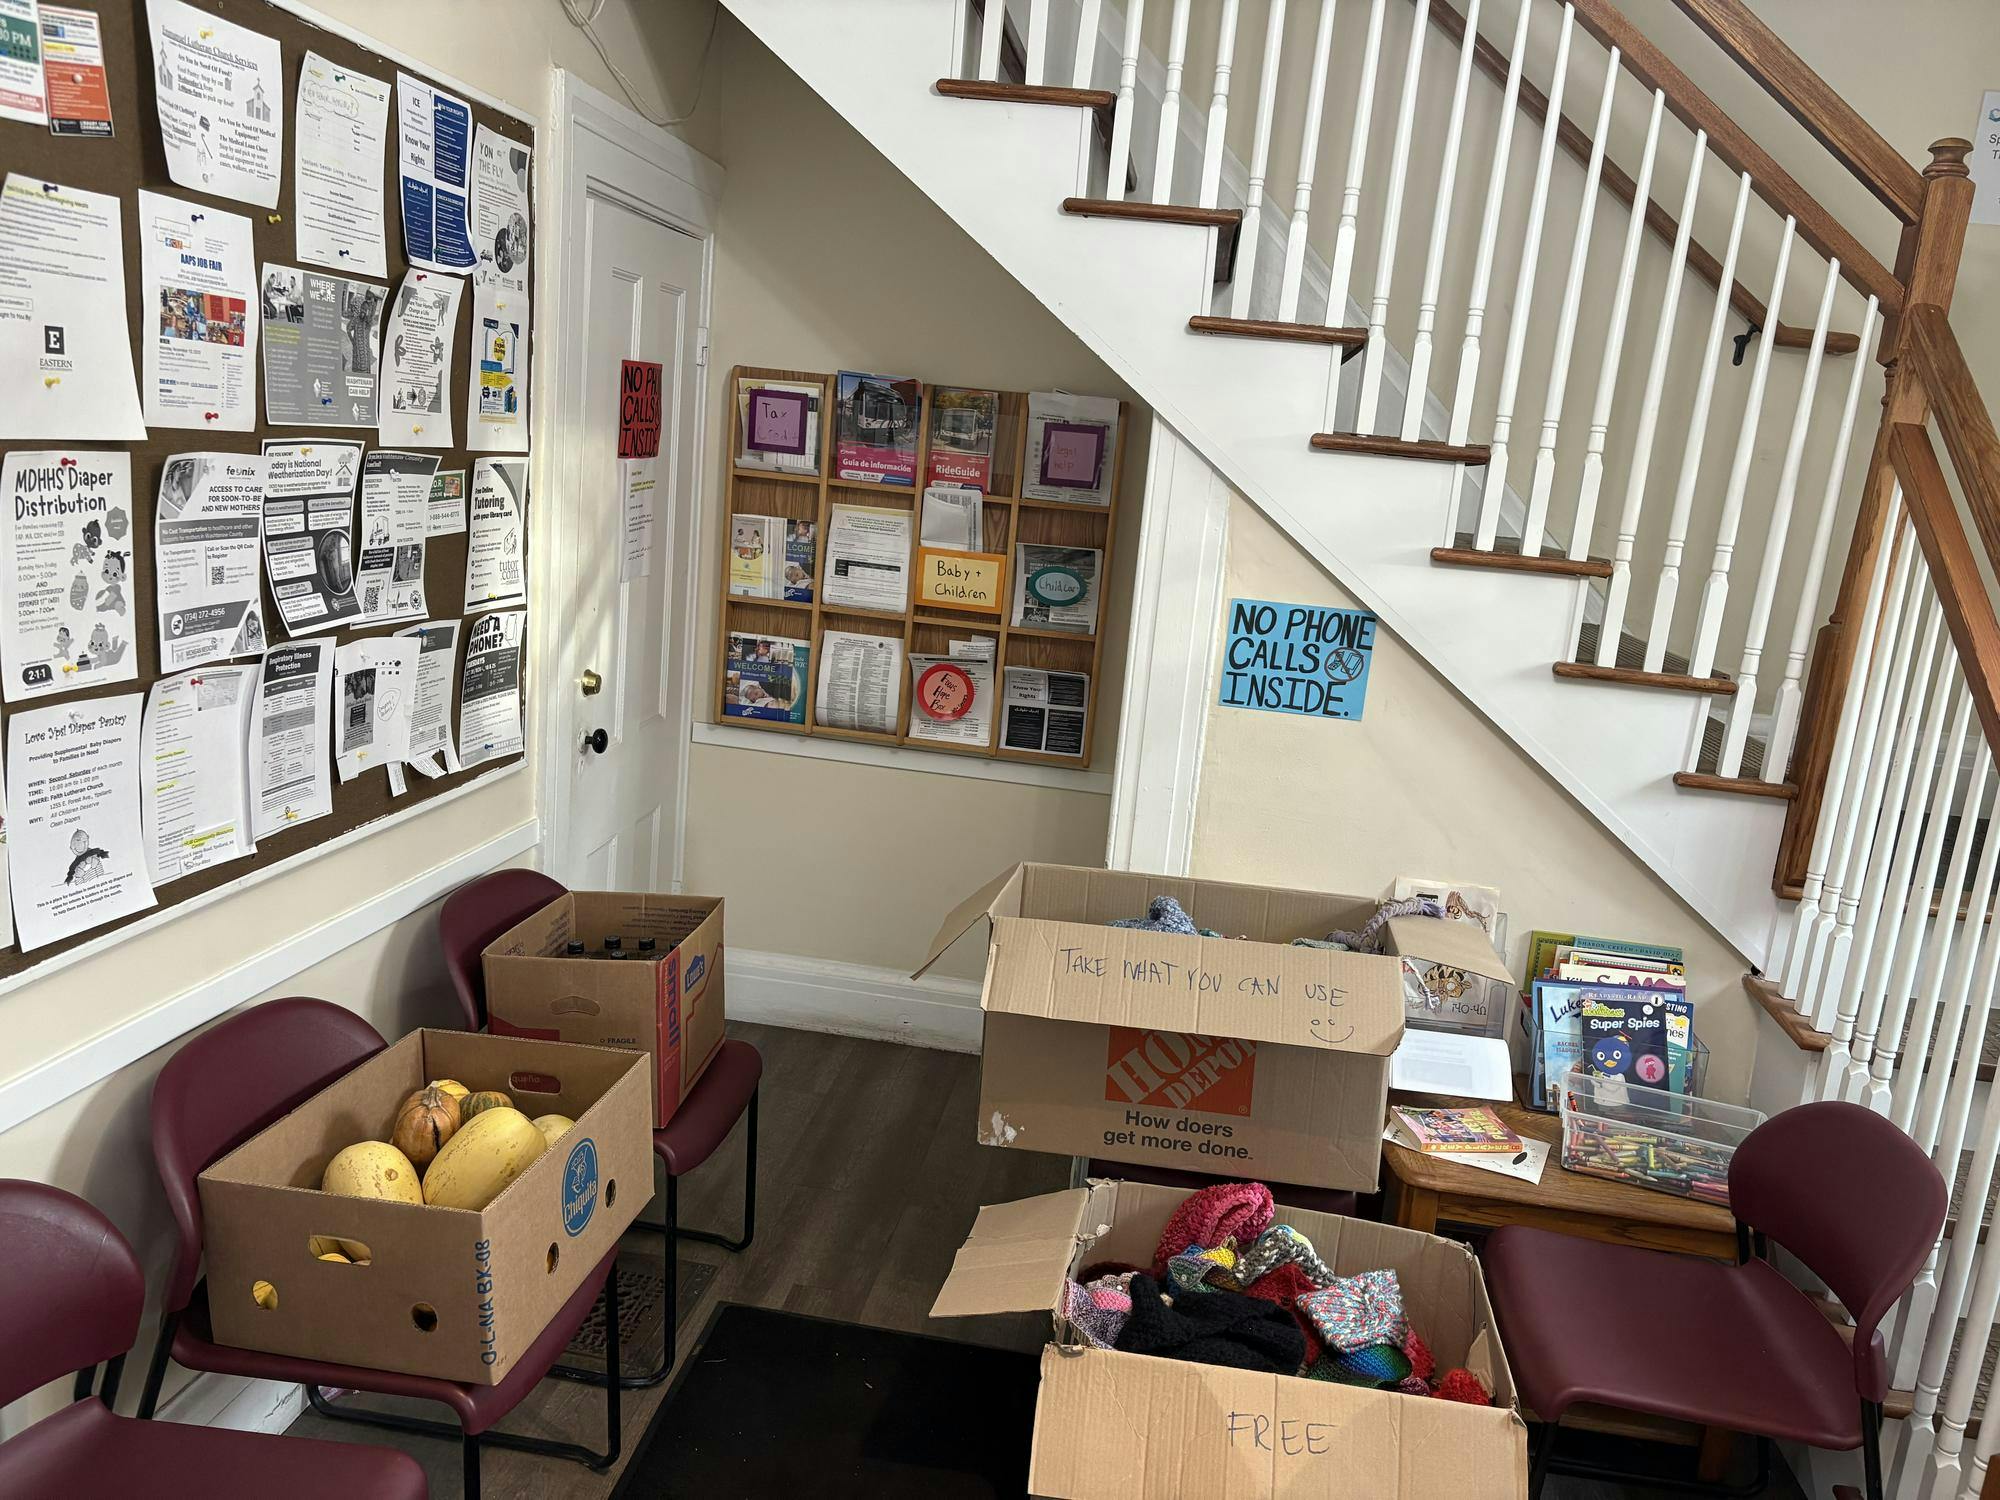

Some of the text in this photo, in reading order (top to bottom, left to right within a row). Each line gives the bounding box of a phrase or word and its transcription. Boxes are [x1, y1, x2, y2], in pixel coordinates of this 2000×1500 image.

[199, 60, 211, 71] Need
[213, 46, 258, 70] Church Services
[412, 97, 421, 109] ICE
[242, 123, 276, 138] Need Medical
[228, 136, 245, 148] Medical
[404, 133, 431, 152] Know Your
[410, 153, 426, 166] Rights
[478, 158, 504, 179] THE FLY
[180, 253, 223, 272] AAPS JOB FAIR
[309, 279, 336, 291] WHERE
[309, 290, 320, 301] WE
[39, 357, 73, 369] EASTERN
[623, 365, 643, 394] NO
[622, 395, 655, 426] CALLS
[762, 402, 788, 419] Tax
[287, 459, 322, 469] is National
[860, 460, 869, 468] de
[870, 460, 912, 474] información
[935, 464, 981, 478] RideGuide
[15, 466, 113, 493] MDHHS Diaper
[268, 468, 333, 480] Weatherization Day!
[209, 485, 263, 493] ACCESS TO CARE
[15, 493, 107, 521] Distribution
[208, 495, 220, 503] FOR
[474, 495, 505, 512] Tutoring
[201, 505, 213, 513] AND
[214, 504, 228, 512] NEW
[481, 509, 513, 521] your library card
[787, 543, 816, 554] LCOME
[499, 559, 519, 572] tutor
[937, 560, 971, 581] Baby
[934, 583, 988, 600] Children
[184, 612, 198, 623] (734)
[472, 618, 501, 640] NEED A
[1232, 603, 1378, 652] NO PHONE
[468, 632, 504, 657] PHONE?
[269, 652, 312, 666] Respiratory Illness
[1228, 636, 1320, 674] CALLS
[275, 662, 301, 673] Protection
[733, 661, 777, 673] WELCOME
[932, 684, 951, 702] Hope
[1222, 671, 1350, 717] INSIDE.
[24, 714, 127, 745] Love Diaper Pantry
[28, 737, 122, 763] Providing Supplemental Baby Diapers
[59, 748, 99, 763] Families Need
[27, 780, 47, 788] WHEN:
[48, 774, 67, 784] Second
[68, 768, 92, 779] Saturday
[27, 789, 44, 798] TIME:
[27, 782, 104, 807] WHERE: Faith Lutheran Church
[28, 816, 44, 825] WHY:
[58, 806, 79, 817] Children
[1060, 947, 1349, 1007] TAKE WHAT YOU CAN USE
[668, 957, 680, 1048] small
[1663, 1002, 1688, 1014] STING
[1590, 1017, 1660, 1031] Super Spies
[511, 1074, 541, 1085] queña
[1125, 1110, 1233, 1138] How doers
[1103, 1130, 1135, 1146] get
[1140, 1133, 1192, 1152] more
[564, 1180, 597, 1226] Chiquita
[1227, 1410, 1337, 1456] FREE
